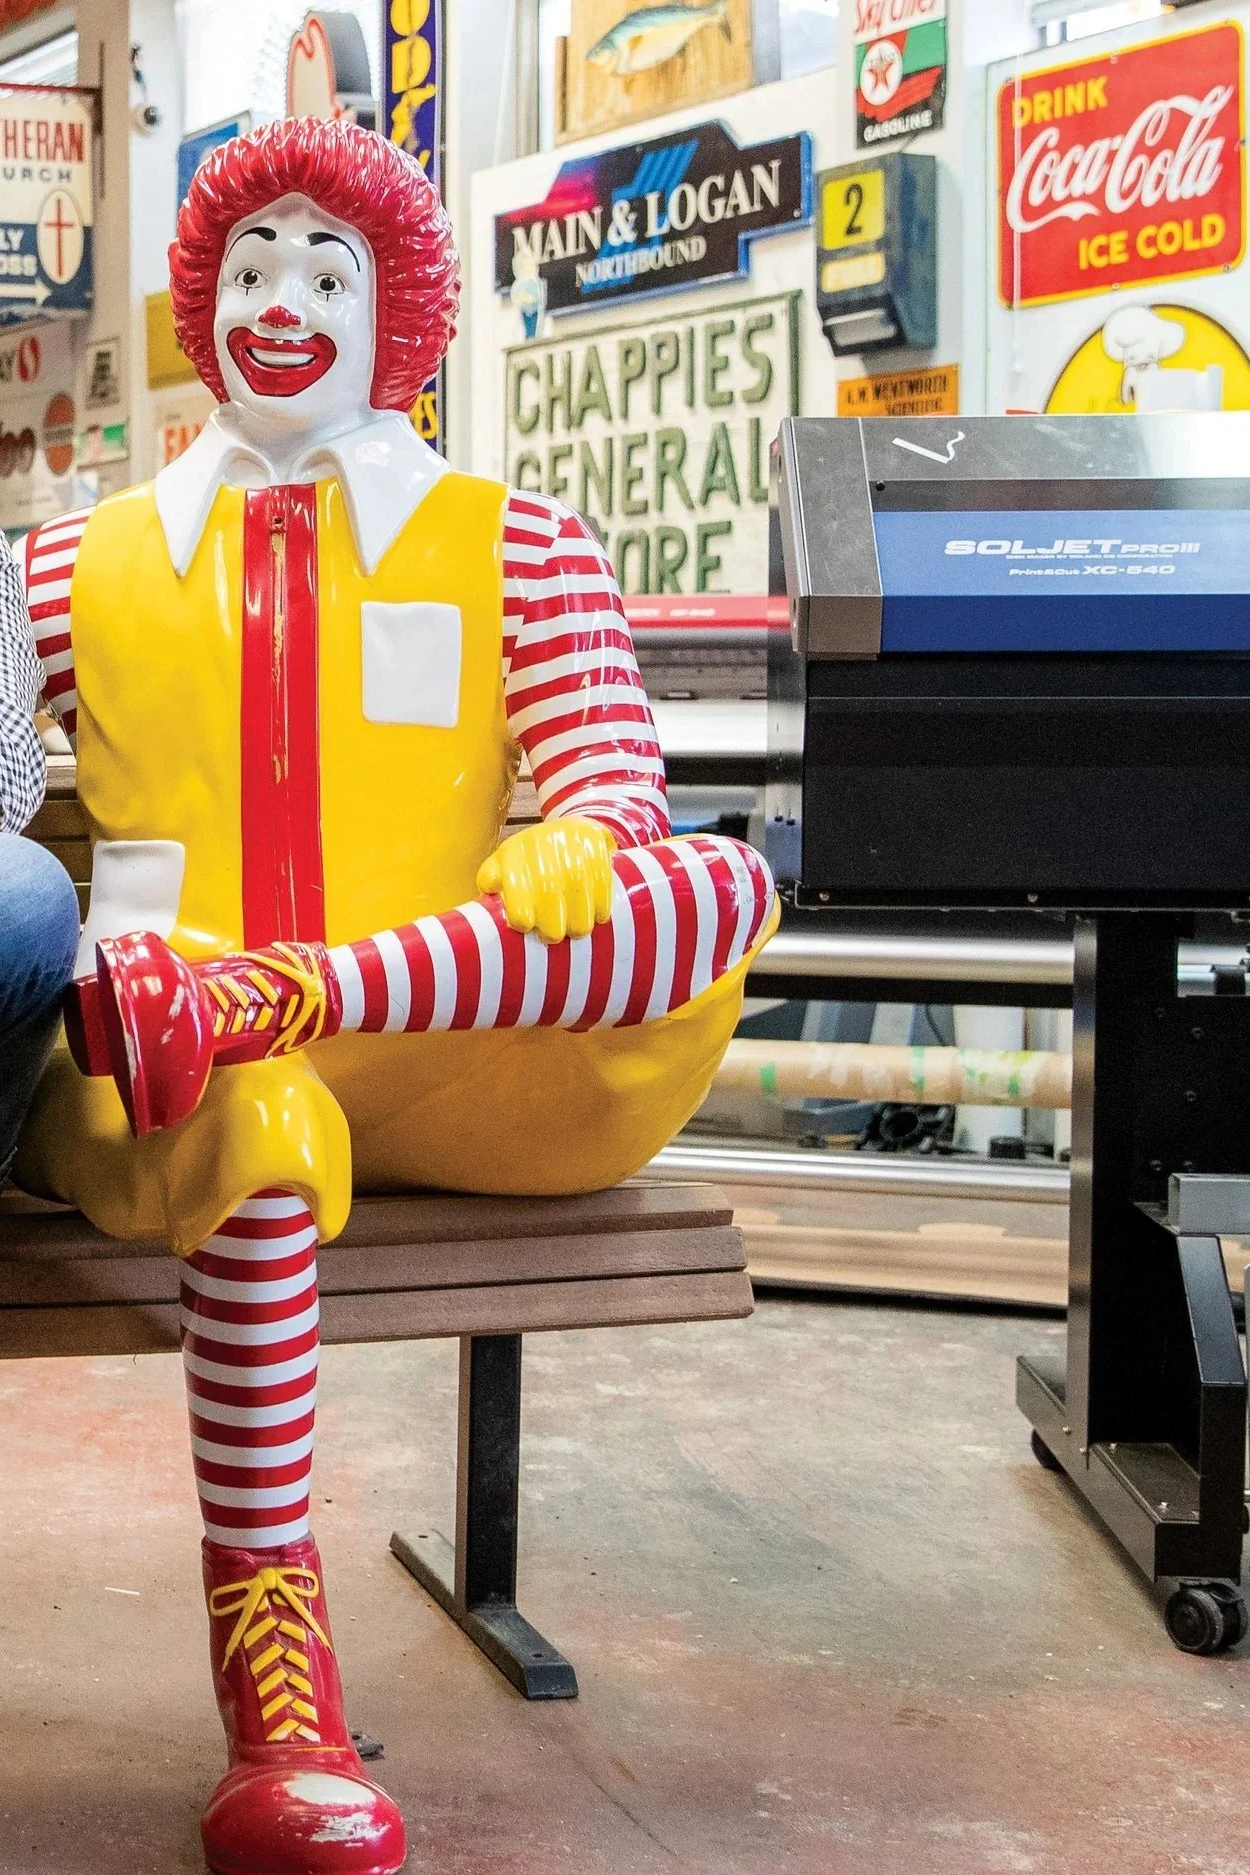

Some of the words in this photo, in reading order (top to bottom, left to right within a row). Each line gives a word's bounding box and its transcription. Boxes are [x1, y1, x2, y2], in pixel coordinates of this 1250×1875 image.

[863, 109, 932, 142] GASOLINE
[1012, 76, 1108, 128] DRINK
[1006, 84, 1236, 234] Coca-Cola
[513, 205, 602, 266] MAIN
[607, 199, 638, 247] &
[645, 159, 782, 238] LOGAN
[845, 183, 864, 236] 2
[575, 235, 707, 288] NORTHBOUND
[1079, 230, 1129, 271] ICE
[1136, 213, 1226, 259] COLD
[512, 312, 774, 436] CHAPPIES
[515, 417, 769, 516] GENERAL
[600, 521, 732, 594] ORE
[944, 540, 1122, 555] SOLJET
[1009, 568, 1080, 576] Print&Cut
[1082, 564, 1176, 575] XC-540
